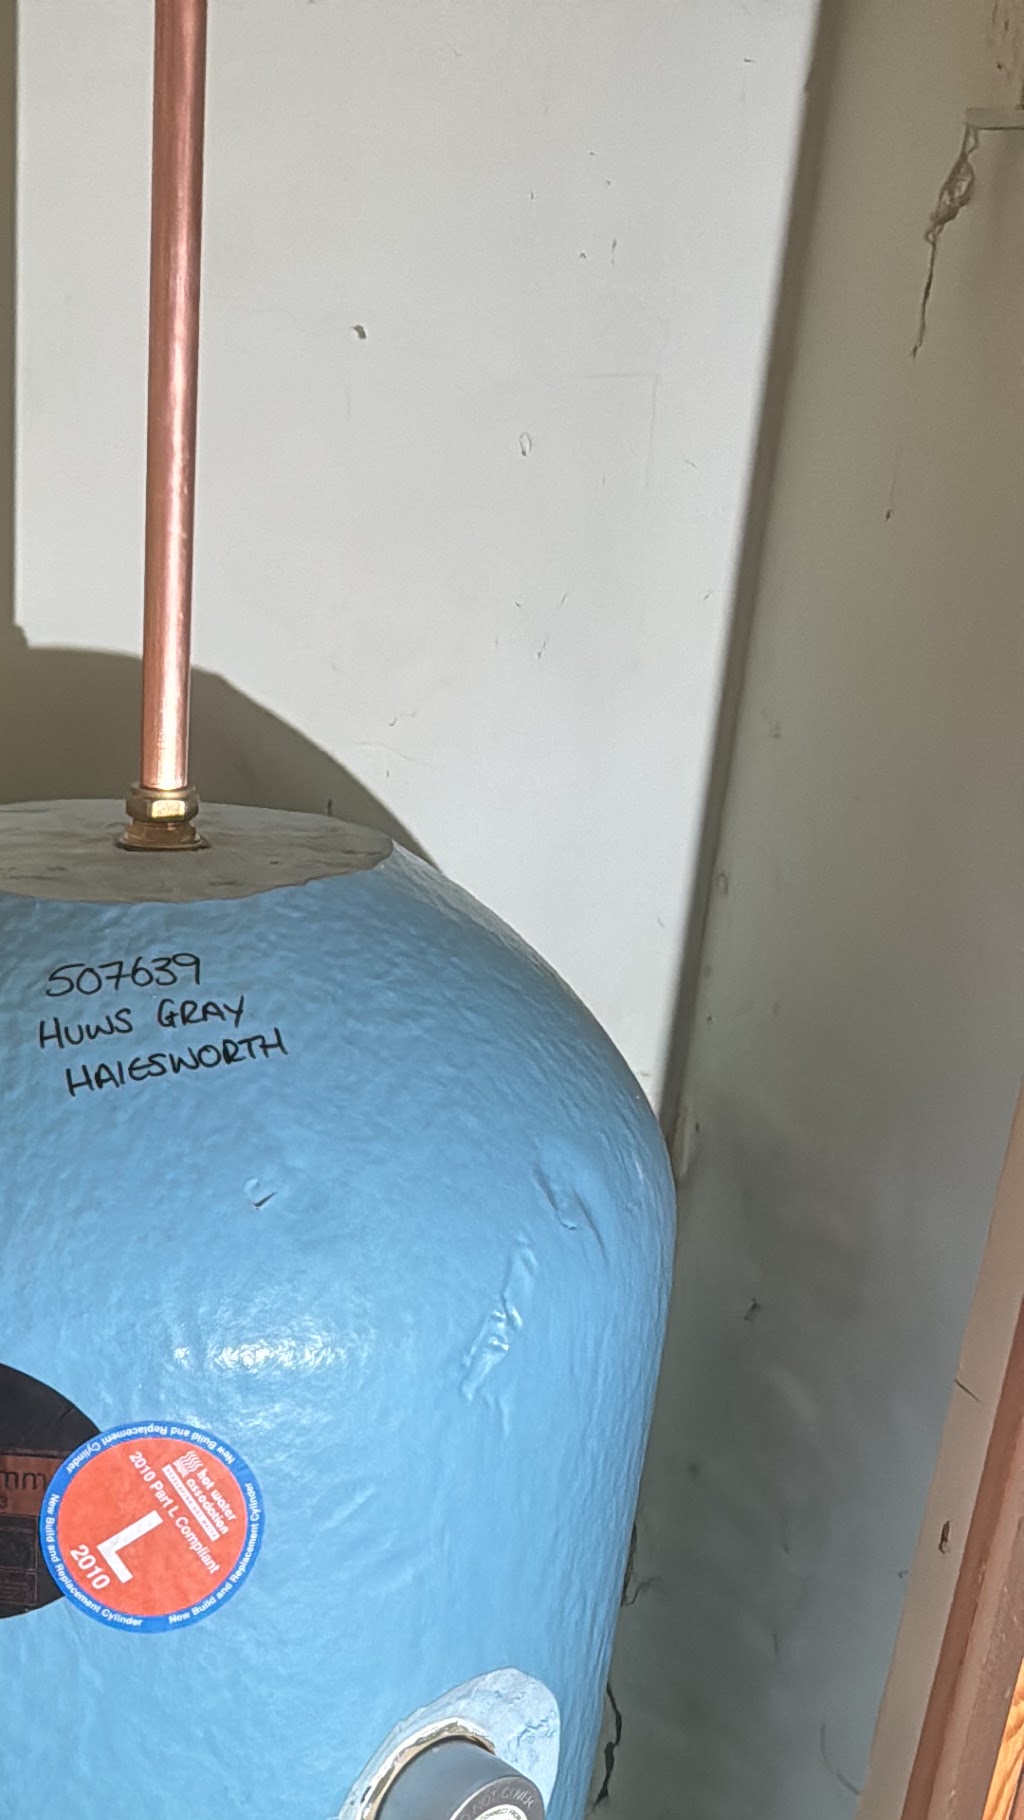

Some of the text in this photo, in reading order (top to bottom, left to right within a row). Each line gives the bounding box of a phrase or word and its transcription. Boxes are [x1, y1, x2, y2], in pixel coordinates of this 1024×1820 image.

[46, 952, 202, 998] 507639
[39, 994, 246, 1050] HUWS GRAY
[66, 1425, 235, 1475] New Build and Replacement Cylinder
[0, 1494, 9, 1510] 3
[129, 1451, 221, 1575] 2010 Part L Compliant
[197, 1468, 237, 1522] hot water
[45, 1493, 143, 1627] New Build and Replacement Cylinder
[69, 1544, 112, 1590] 2010
[96, 1509, 164, 1584] L
[168, 1482, 261, 1624] New Build and Replacement Cylinder
